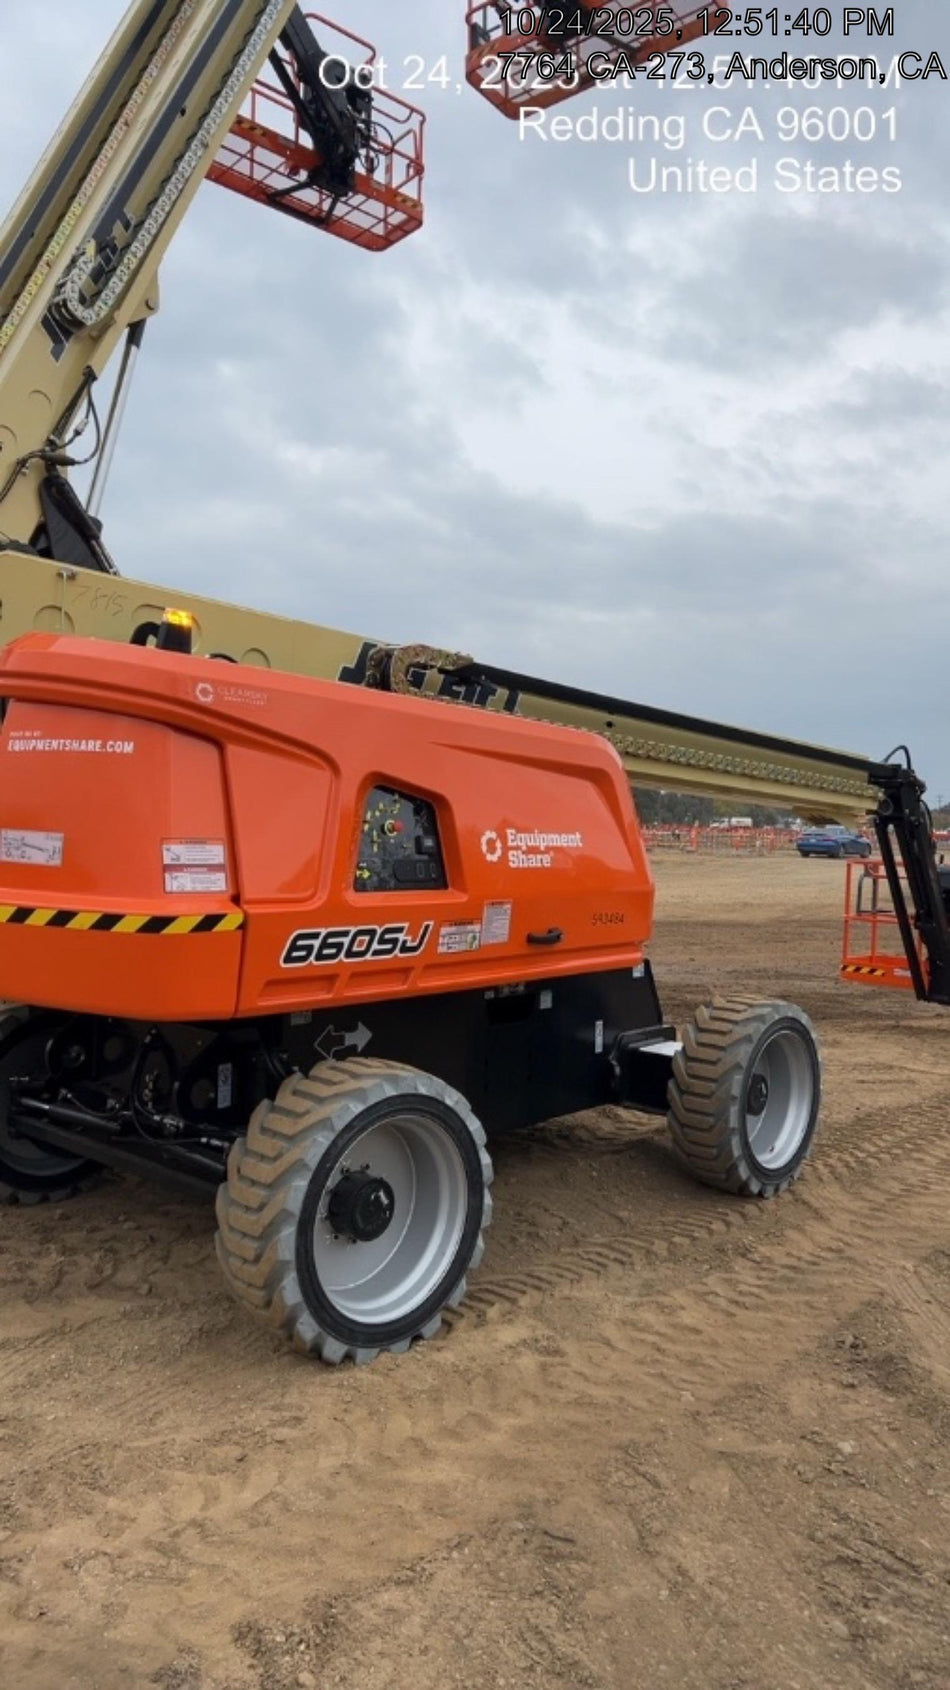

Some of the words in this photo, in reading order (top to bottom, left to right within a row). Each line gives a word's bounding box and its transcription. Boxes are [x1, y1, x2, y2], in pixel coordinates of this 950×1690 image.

[8, 740, 134, 753] EQUIPMENTSHARE.COM
[506, 829, 582, 851] Equipment
[279, 920, 434, 967] 660SJ
